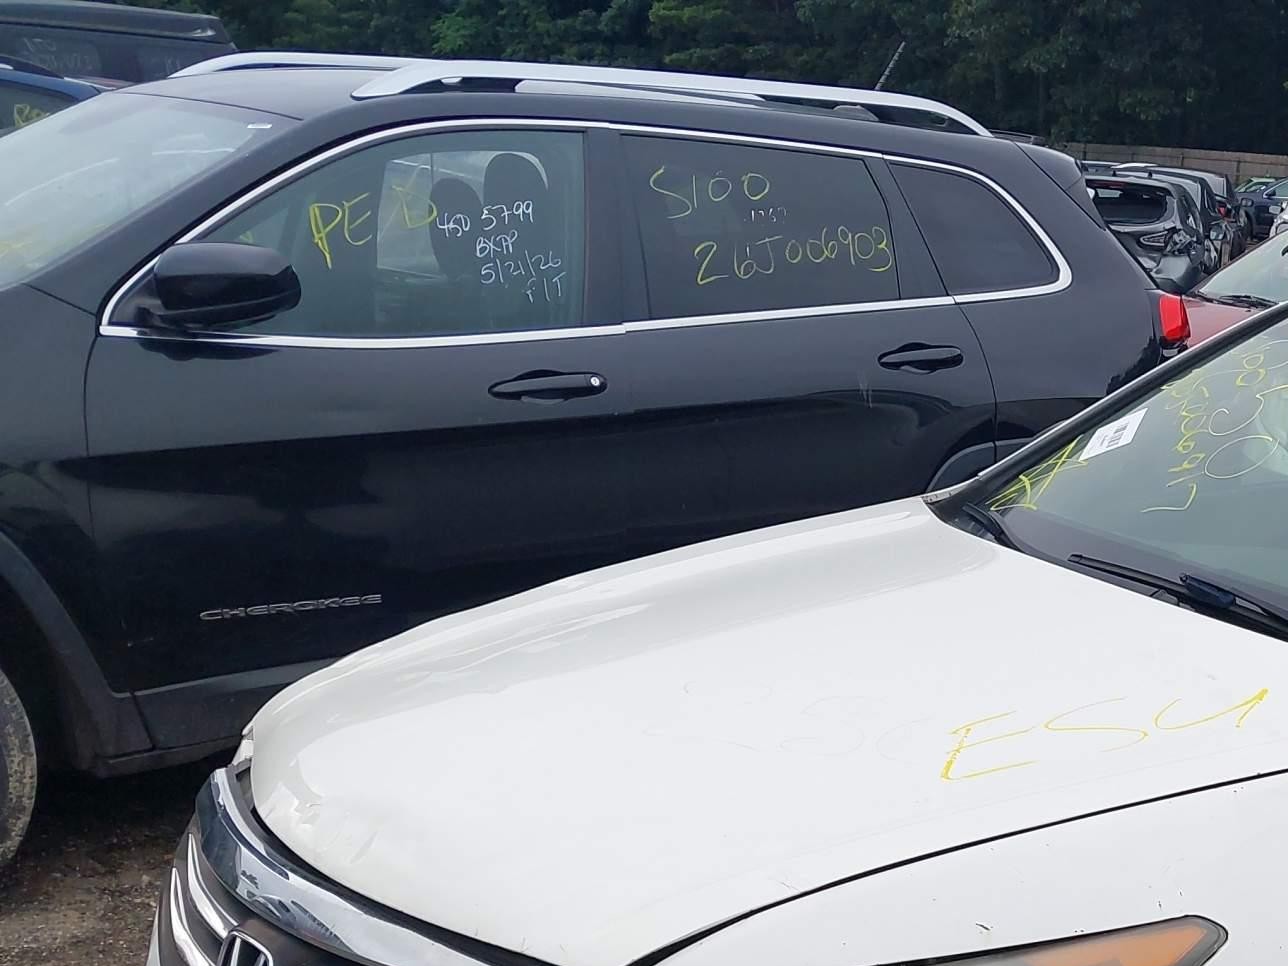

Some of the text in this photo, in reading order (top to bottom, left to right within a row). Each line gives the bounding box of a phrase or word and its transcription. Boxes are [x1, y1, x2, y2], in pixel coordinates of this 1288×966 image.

[650, 165, 770, 219] S100
[480, 200, 534, 230] 5799
[199, 593, 383, 621] CHEROKEE
